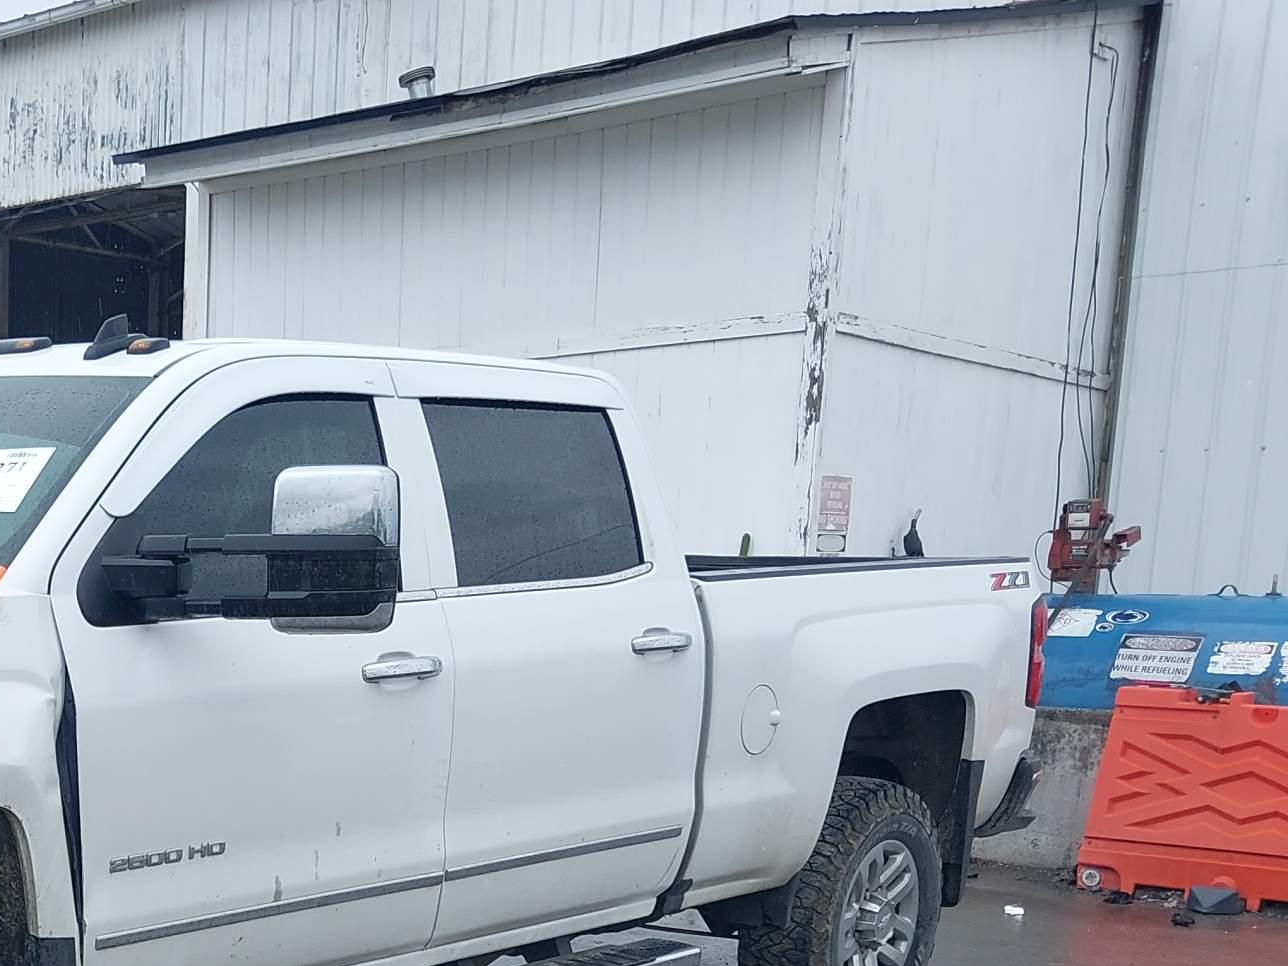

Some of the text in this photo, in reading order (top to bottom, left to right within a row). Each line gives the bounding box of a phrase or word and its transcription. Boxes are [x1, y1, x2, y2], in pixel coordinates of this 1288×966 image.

[989, 570, 1031, 592] Z71
[1117, 653, 1193, 665] TURN OFF ENGINE
[1112, 664, 1189, 676] WHILE REFUELING
[109, 841, 226, 874] 2500 HD
